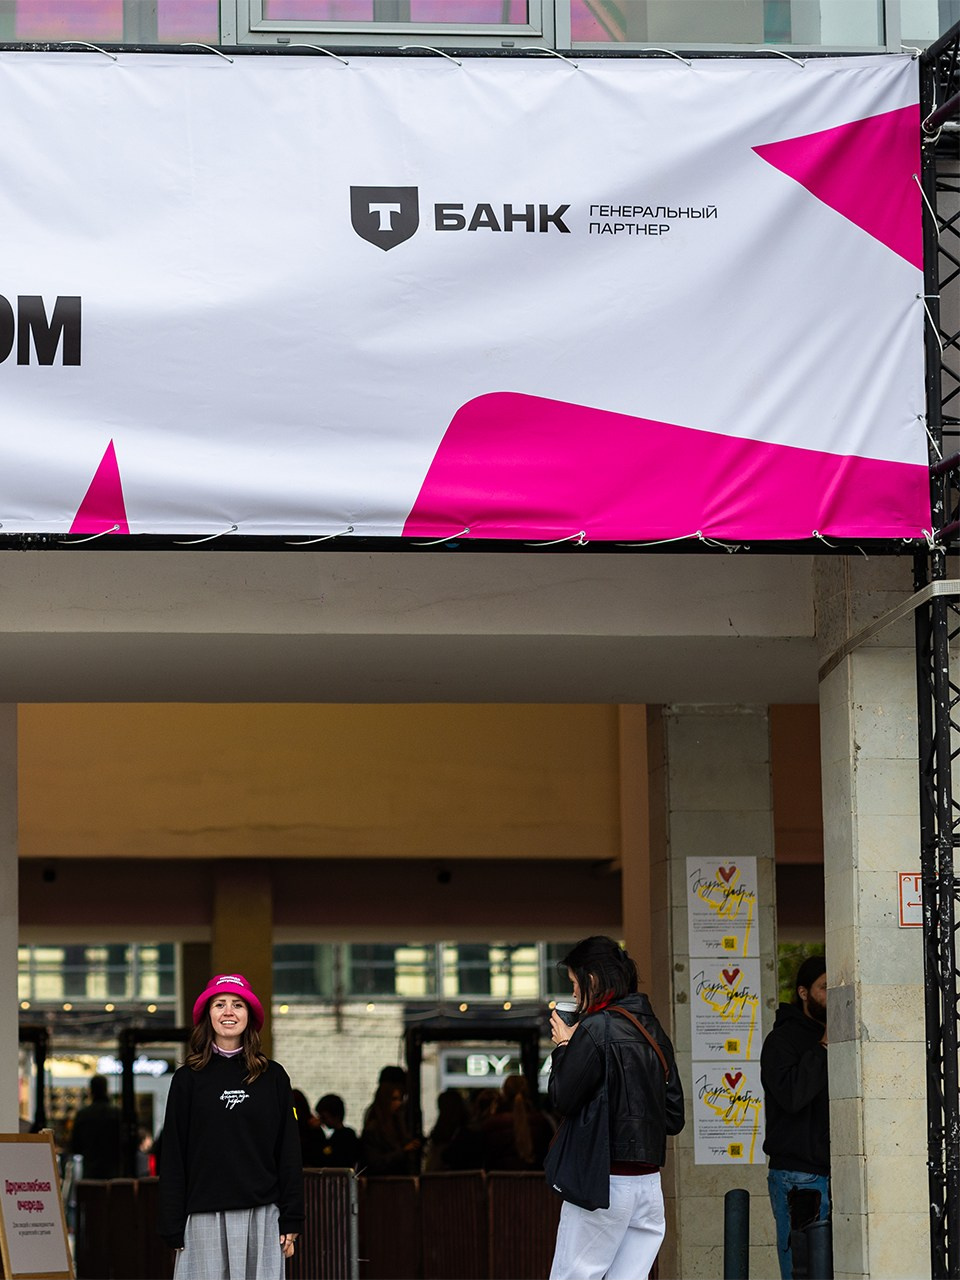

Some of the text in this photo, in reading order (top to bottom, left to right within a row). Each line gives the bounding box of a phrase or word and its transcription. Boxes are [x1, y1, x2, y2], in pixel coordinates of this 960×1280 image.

[434, 203, 572, 234] БАНК
[589, 204, 718, 219] ГЕНЕРАЛЬНЫЙ
[589, 222, 670, 236] ПАРТНЕР
